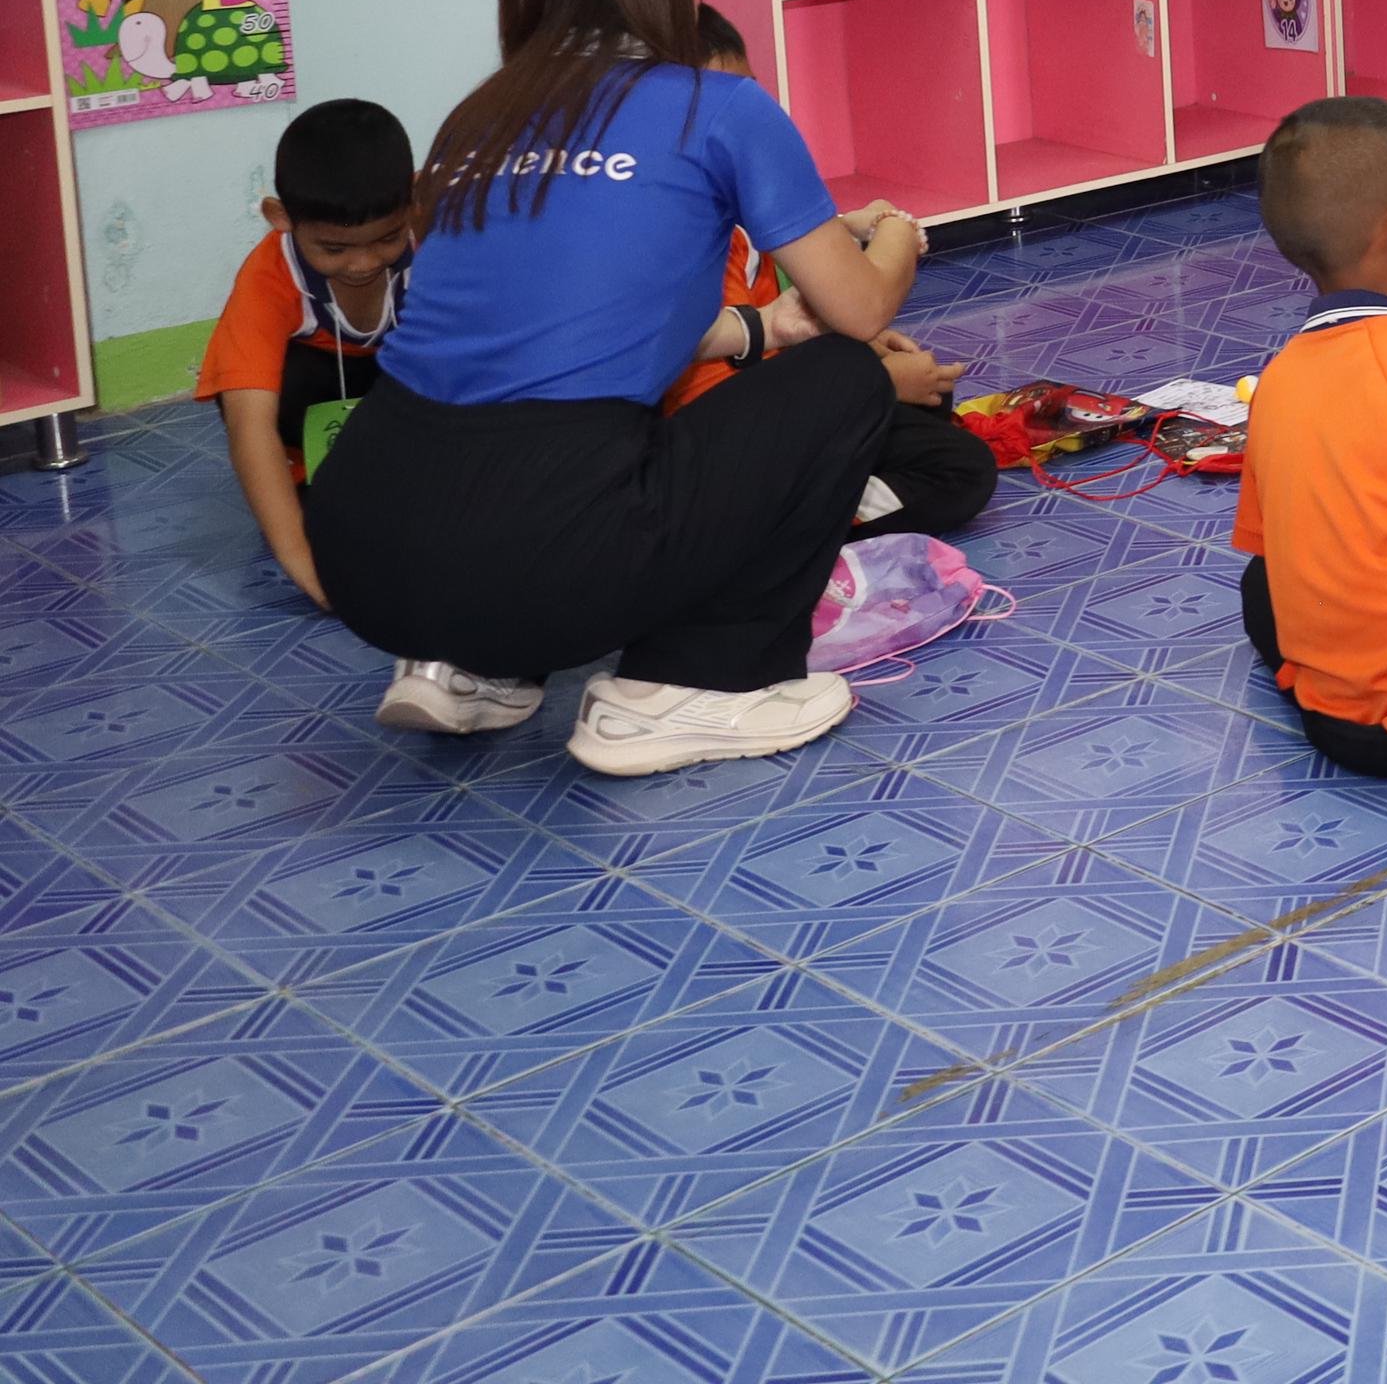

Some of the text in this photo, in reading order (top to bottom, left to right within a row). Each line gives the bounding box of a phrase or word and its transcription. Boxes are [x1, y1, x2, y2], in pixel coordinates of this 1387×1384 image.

[241, 13, 271, 33] 50
[1281, 20, 1297, 42] 14
[248, 82, 279, 100] 40
[448, 148, 638, 187] ience
